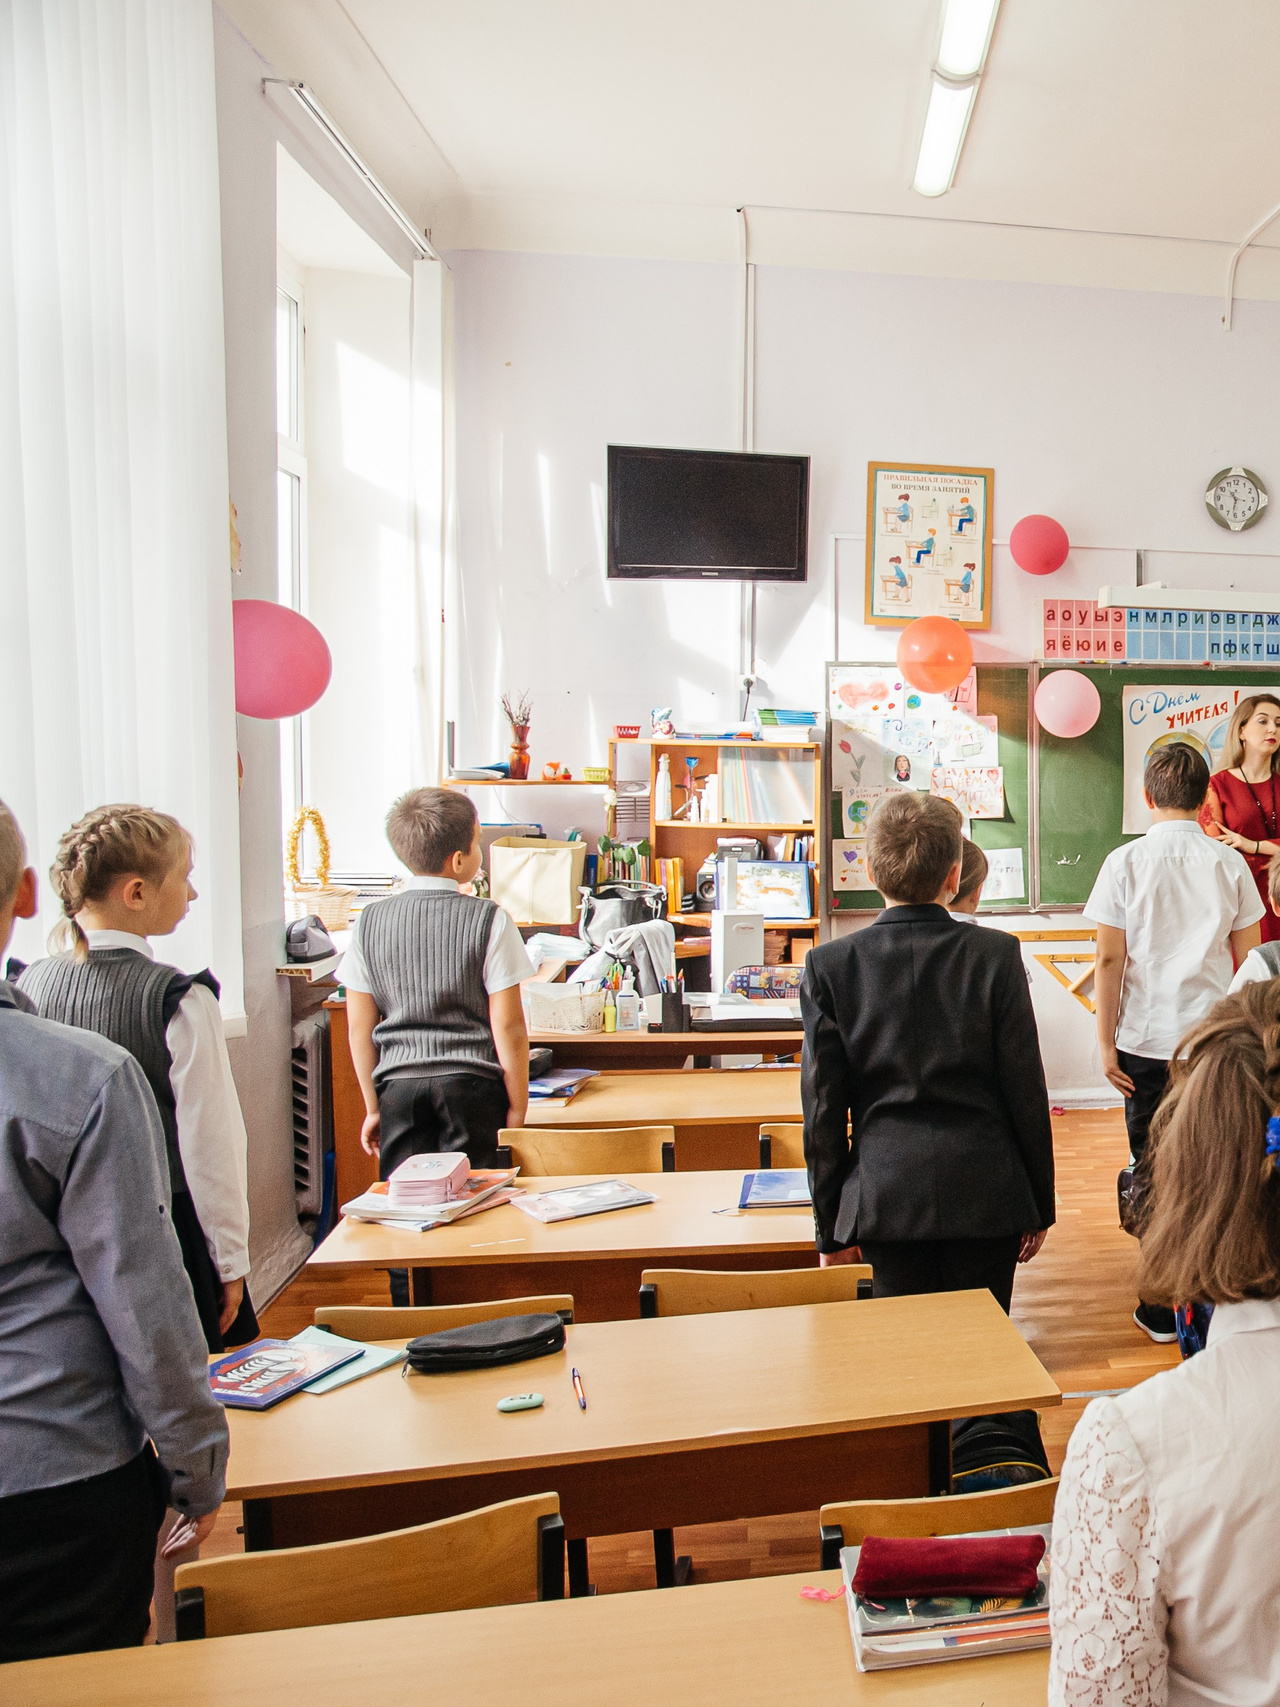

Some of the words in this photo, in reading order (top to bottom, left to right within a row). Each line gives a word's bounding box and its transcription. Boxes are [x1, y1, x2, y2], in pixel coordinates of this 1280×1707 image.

[884, 474, 938, 483] ПРАВИЛЬНАЯ
[940, 476, 978, 486] ПОСАДКА
[904, 484, 930, 492] ВРЕМЯ
[932, 484, 970, 494] ЗАНЯТИЙ
[1129, 698, 1147, 726] С
[1146, 691, 1201, 714] Днём
